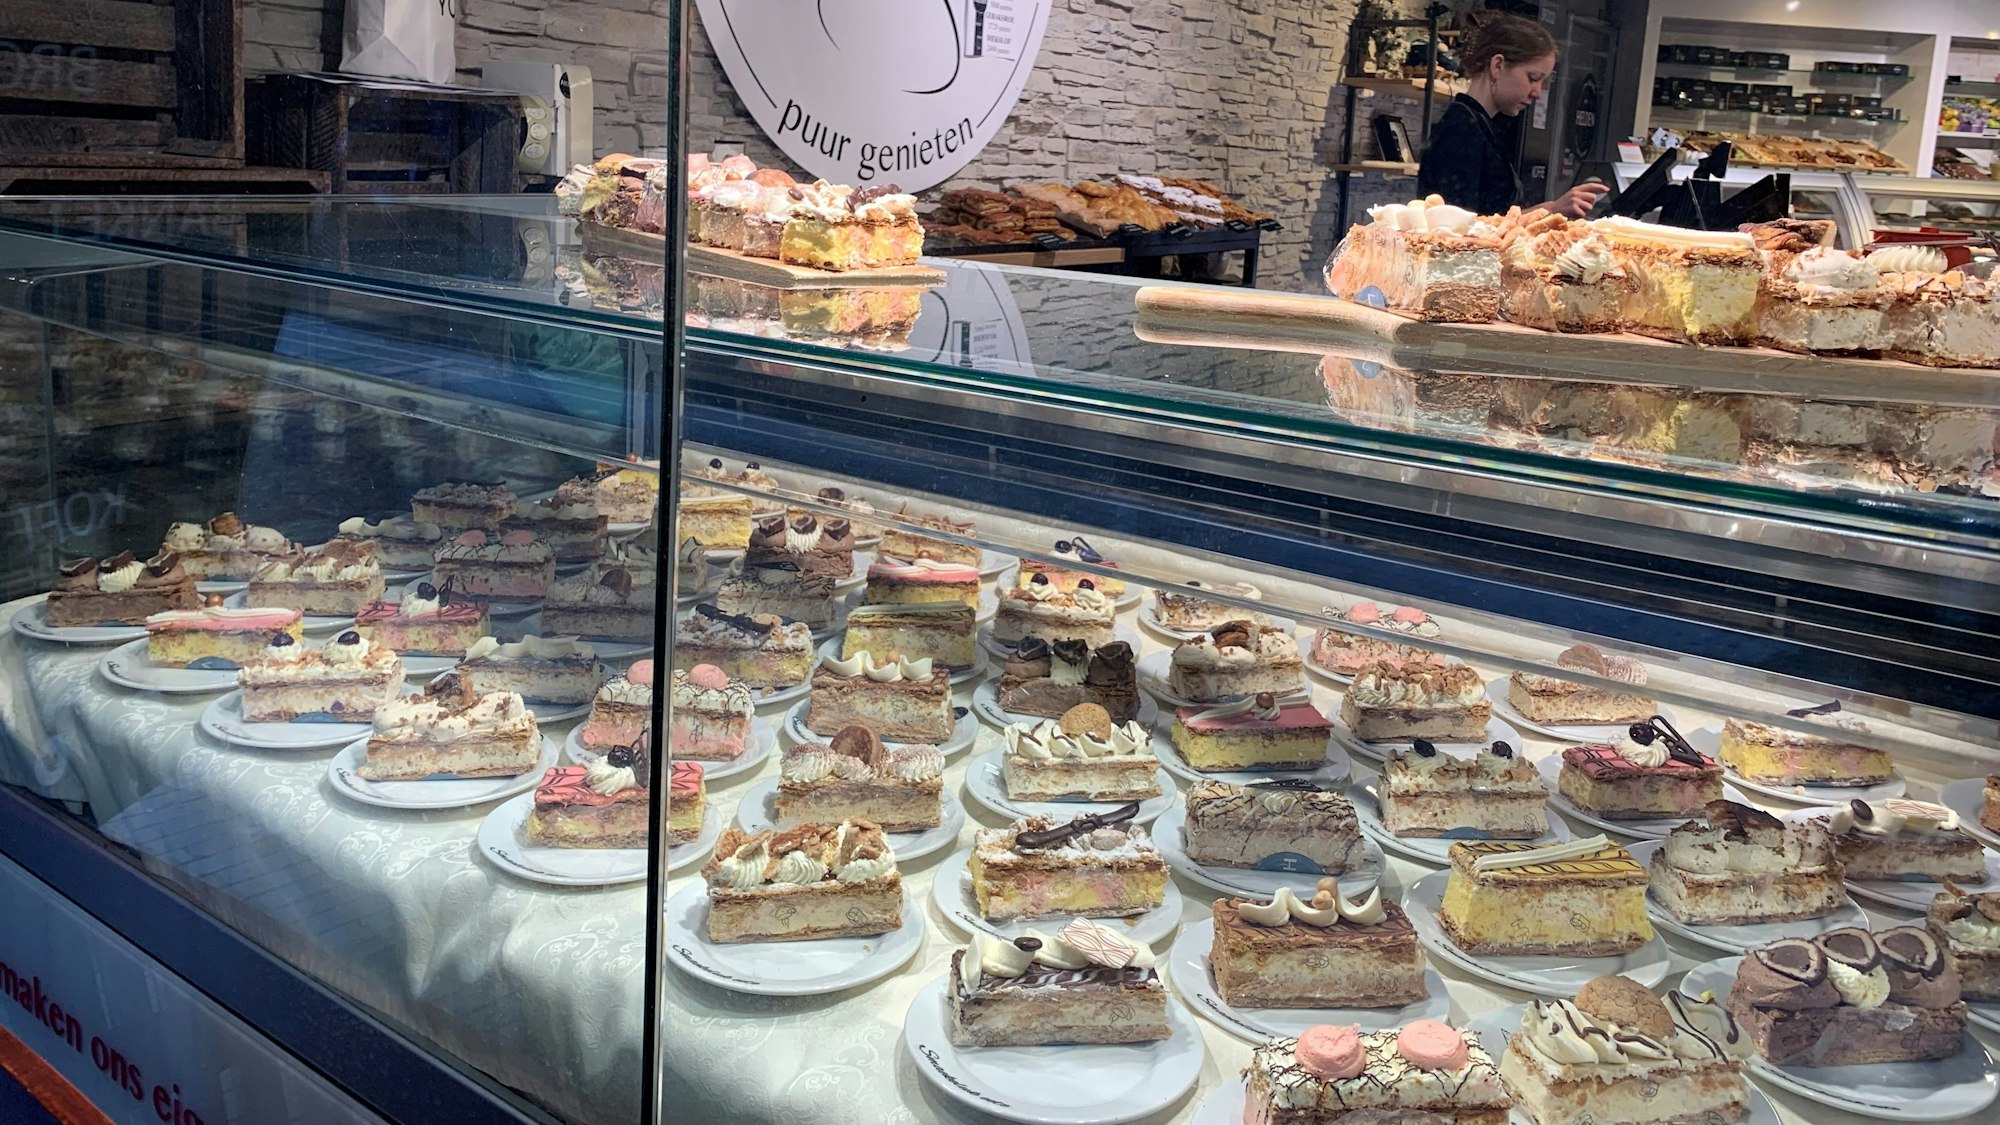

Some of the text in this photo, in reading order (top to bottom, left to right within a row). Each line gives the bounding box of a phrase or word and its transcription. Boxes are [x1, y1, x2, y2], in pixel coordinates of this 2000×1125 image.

[777, 98, 974, 181] puur genieten
[0, 961, 84, 1054] maken
[90, 1036, 145, 1101] ons
